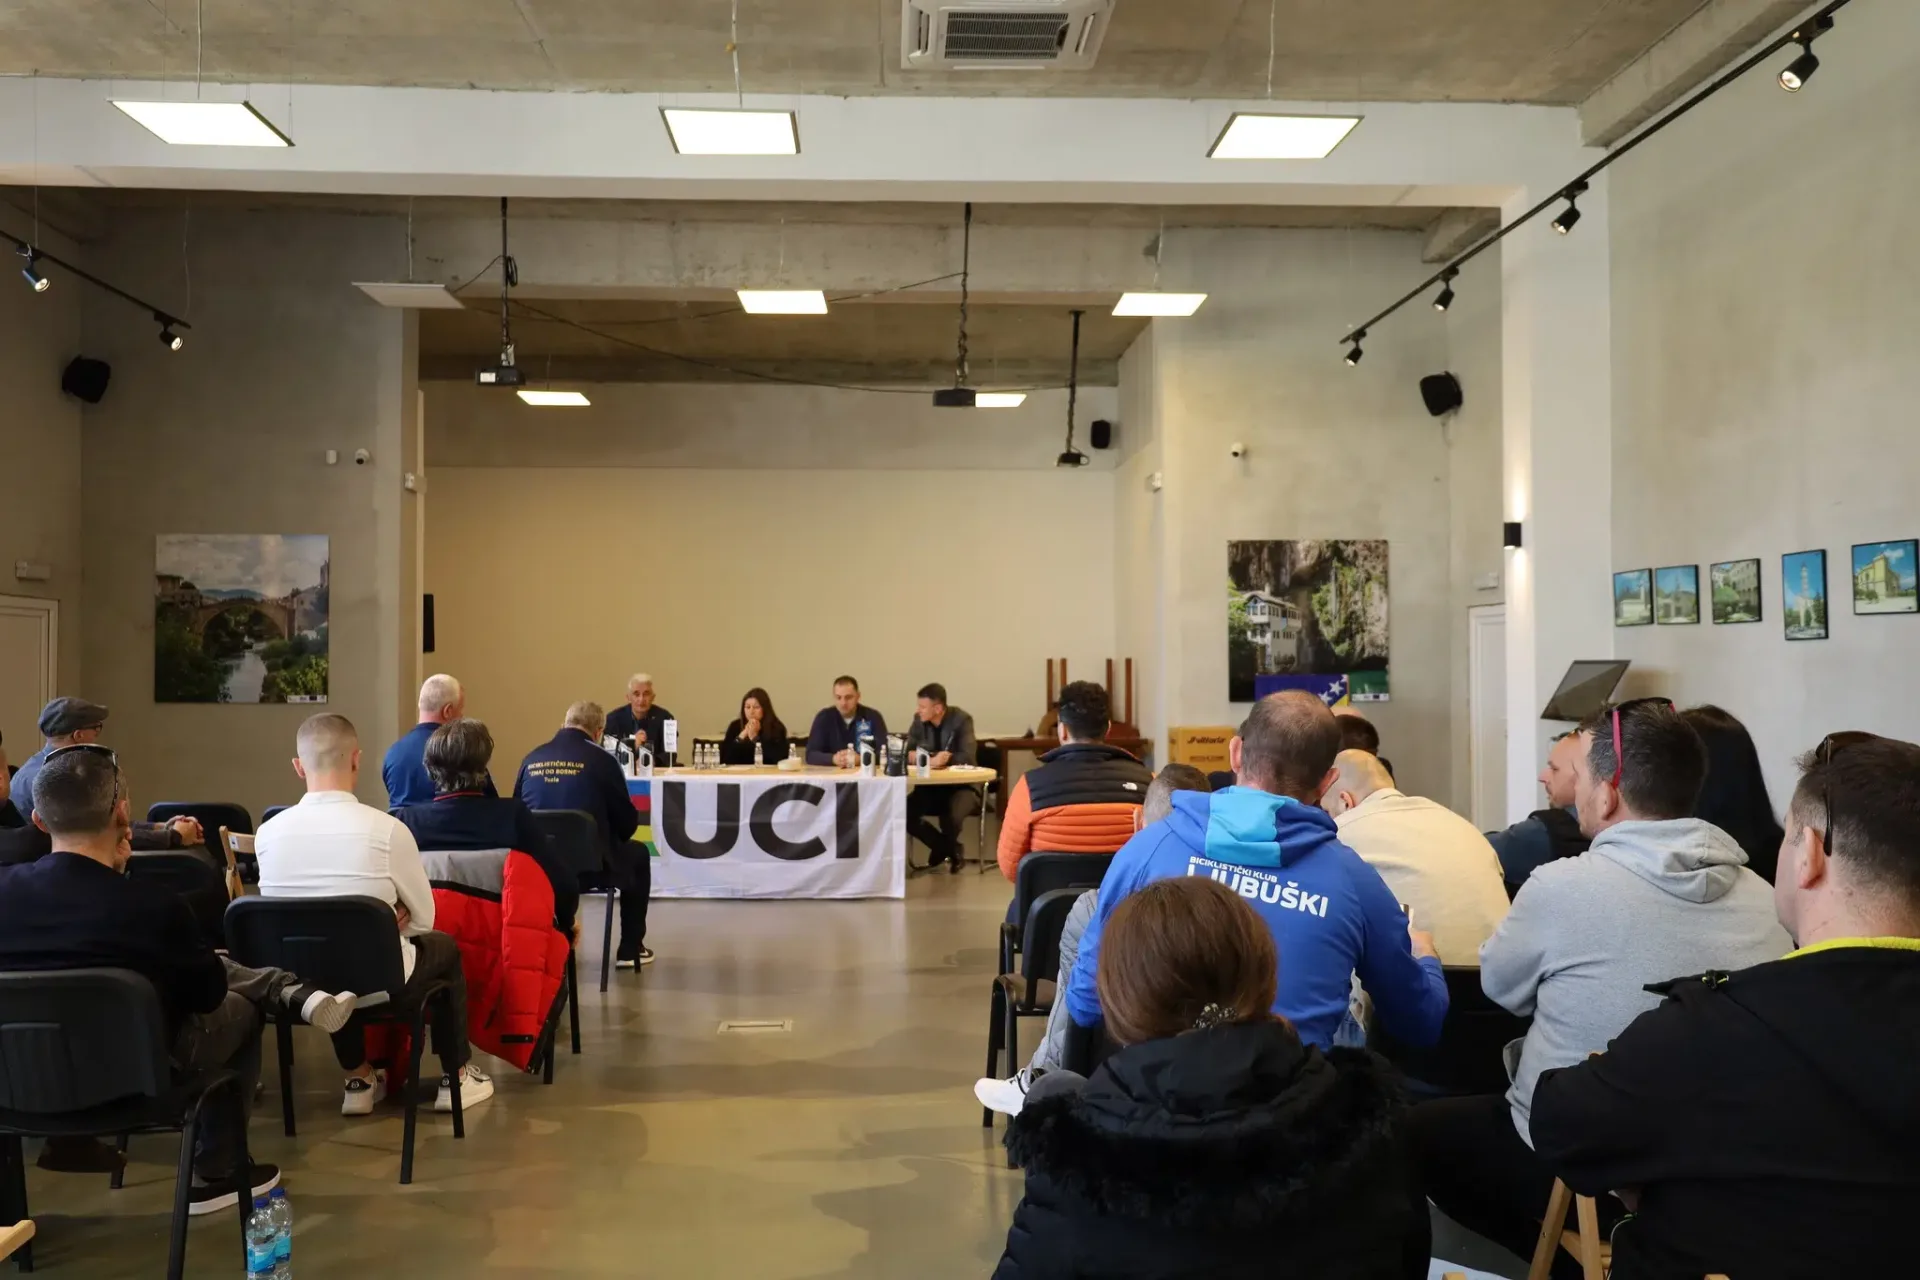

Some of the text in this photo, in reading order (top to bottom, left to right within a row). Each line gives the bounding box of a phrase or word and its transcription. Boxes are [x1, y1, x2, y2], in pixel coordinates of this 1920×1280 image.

[567, 761, 584, 769] KLUB
[662, 781, 859, 860] UCI
[1189, 856, 1278, 883] BICIKLISTIČKI KLUB
